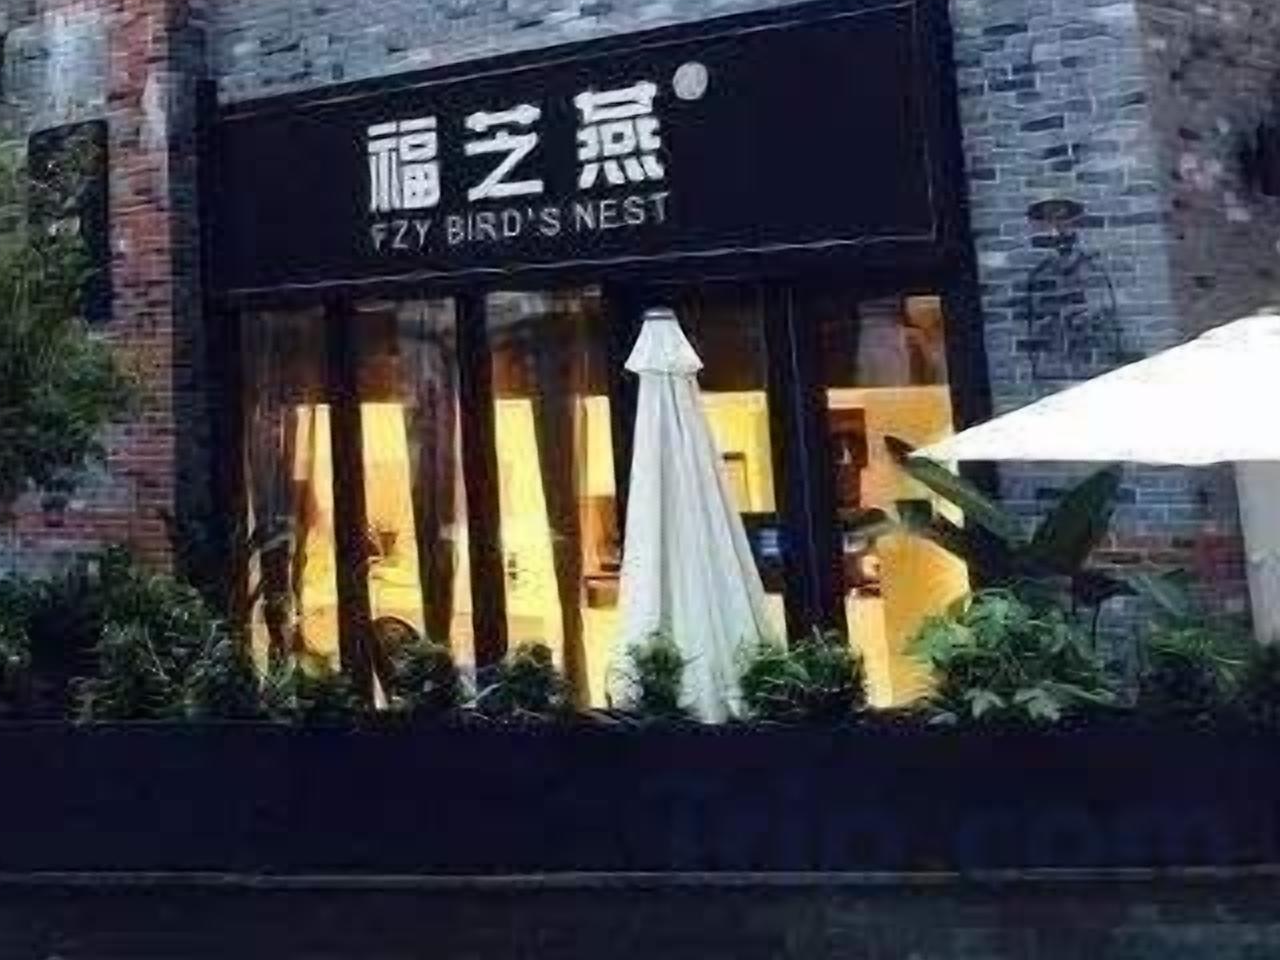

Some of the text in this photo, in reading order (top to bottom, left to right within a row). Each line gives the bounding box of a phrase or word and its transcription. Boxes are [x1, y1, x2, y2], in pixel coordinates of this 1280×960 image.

[367, 80, 665, 213] 福芝燕
[446, 207, 562, 245] BIRD'S
[574, 192, 671, 233] NEST
